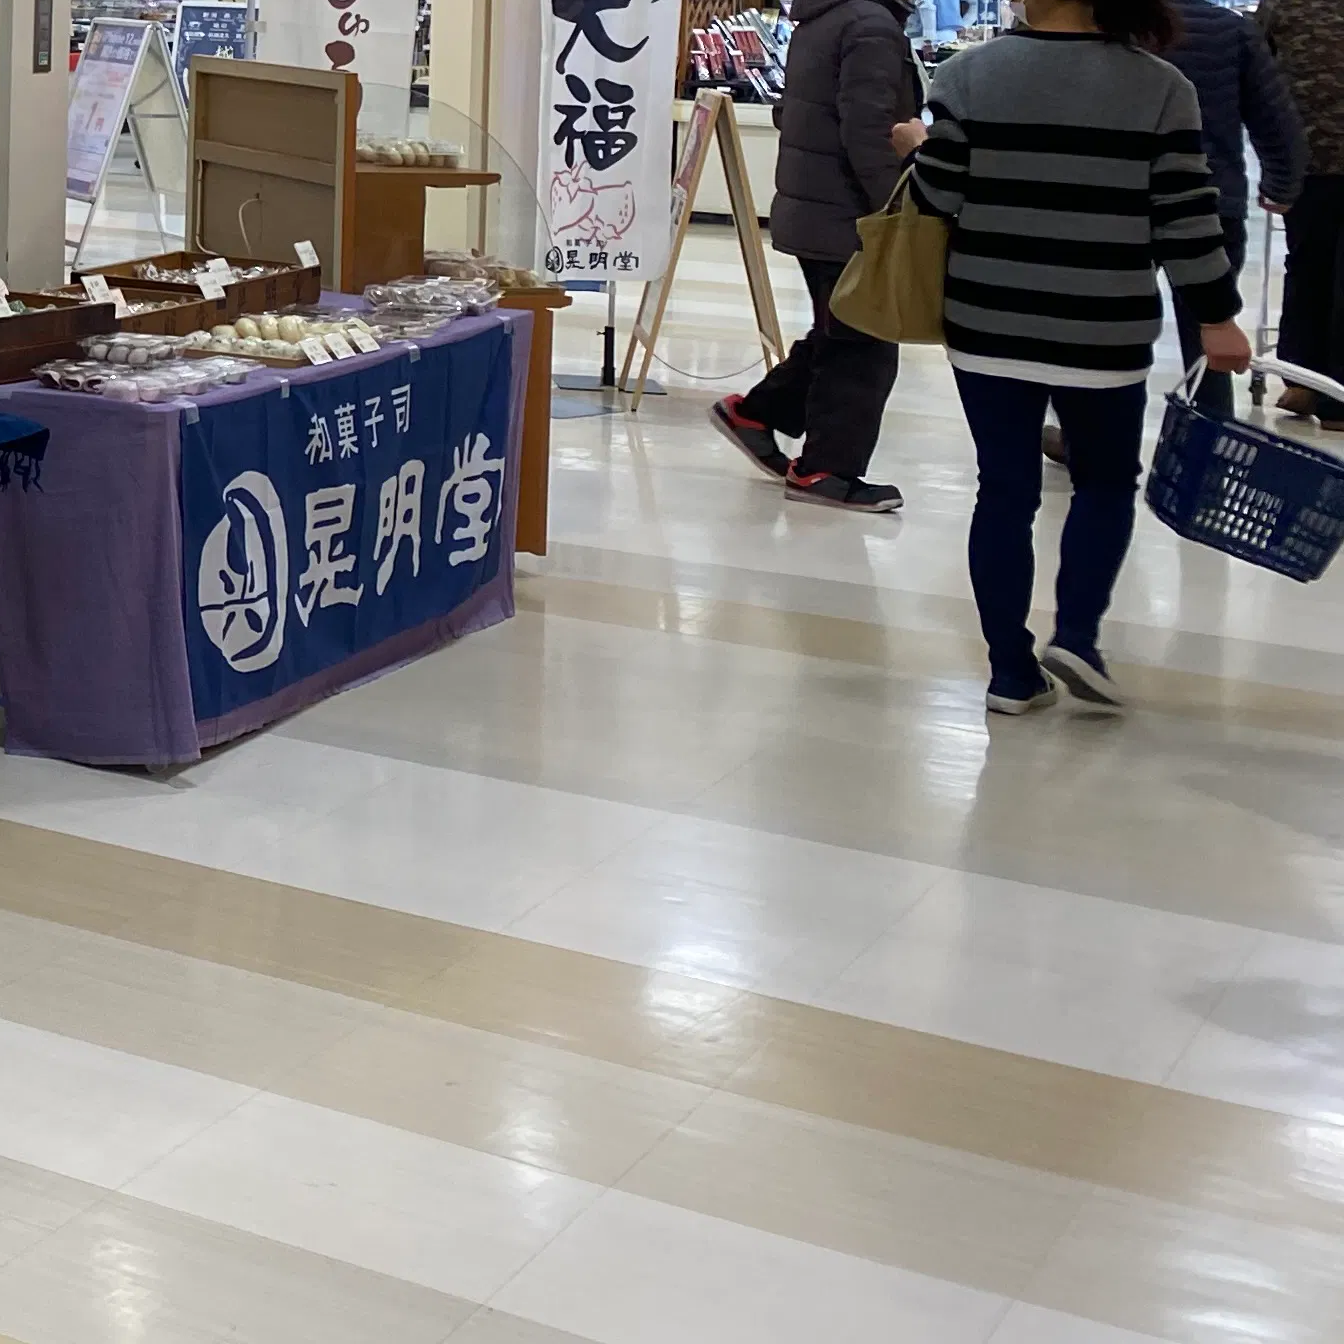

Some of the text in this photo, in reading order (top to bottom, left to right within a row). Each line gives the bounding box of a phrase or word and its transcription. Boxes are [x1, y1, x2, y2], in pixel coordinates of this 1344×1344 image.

[565, 250, 640, 271] 晃明堂
[304, 383, 412, 465] 和菓子司
[294, 432, 506, 628] 晃明堂
